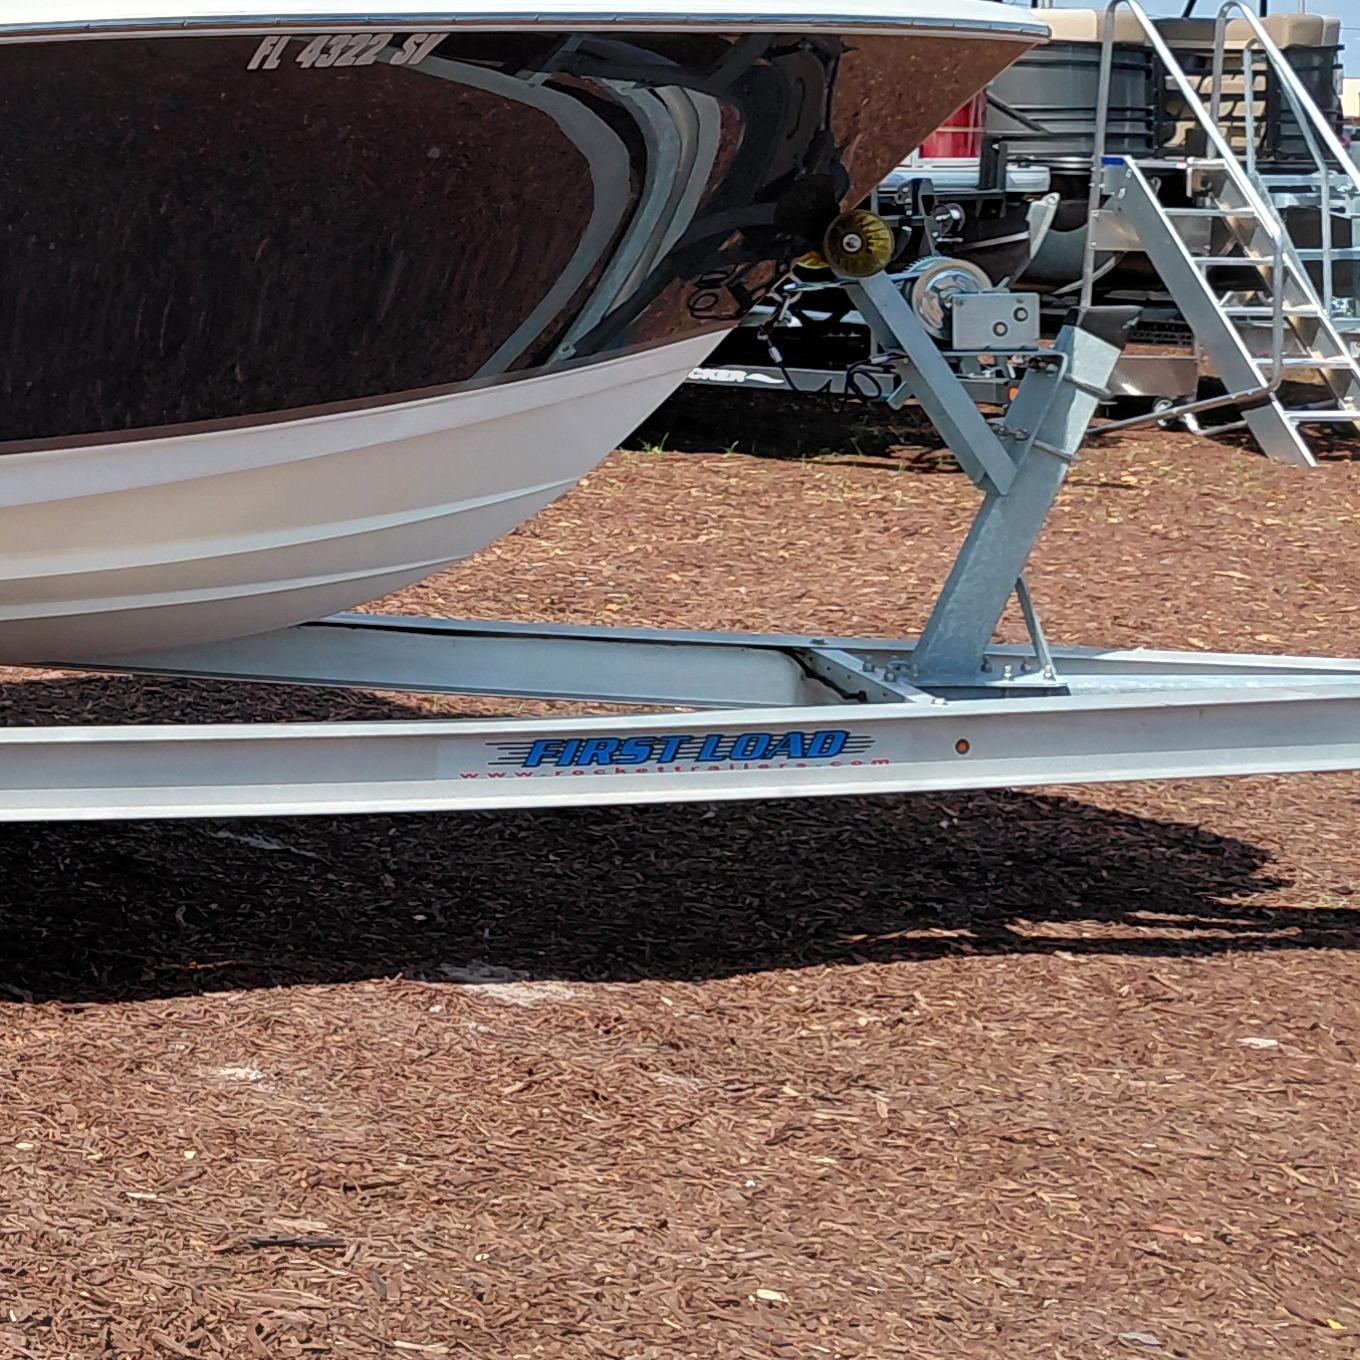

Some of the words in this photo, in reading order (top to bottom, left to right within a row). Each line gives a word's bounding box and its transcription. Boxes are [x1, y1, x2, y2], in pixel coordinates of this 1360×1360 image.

[246, 35, 292, 71] FL
[295, 32, 394, 69] 4322
[521, 735, 696, 768] FIRST
[694, 729, 851, 763] LOAD
[459, 757, 891, 780] www.rockettrailers.com
